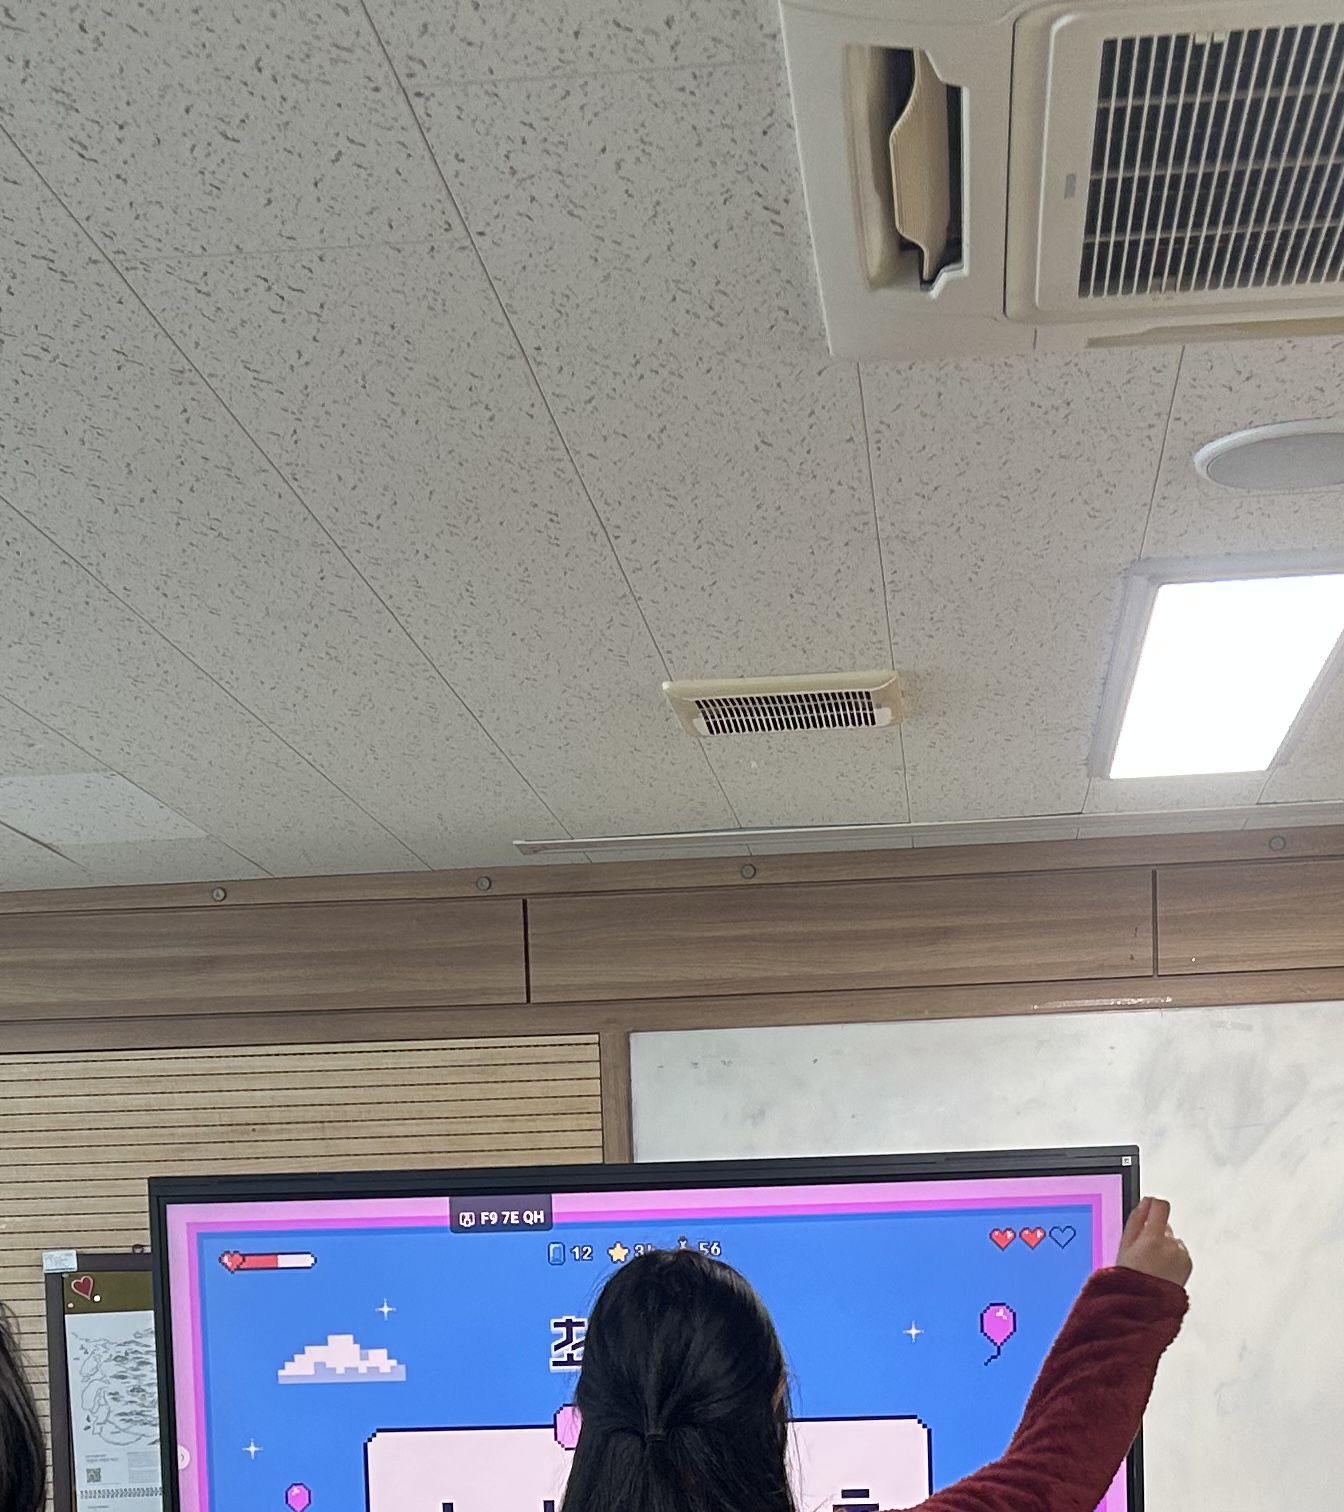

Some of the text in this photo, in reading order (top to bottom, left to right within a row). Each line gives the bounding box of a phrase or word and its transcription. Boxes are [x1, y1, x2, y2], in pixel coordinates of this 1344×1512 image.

[480, 1209, 545, 1225] F9 7E QH
[570, 1245, 593, 1262] 12
